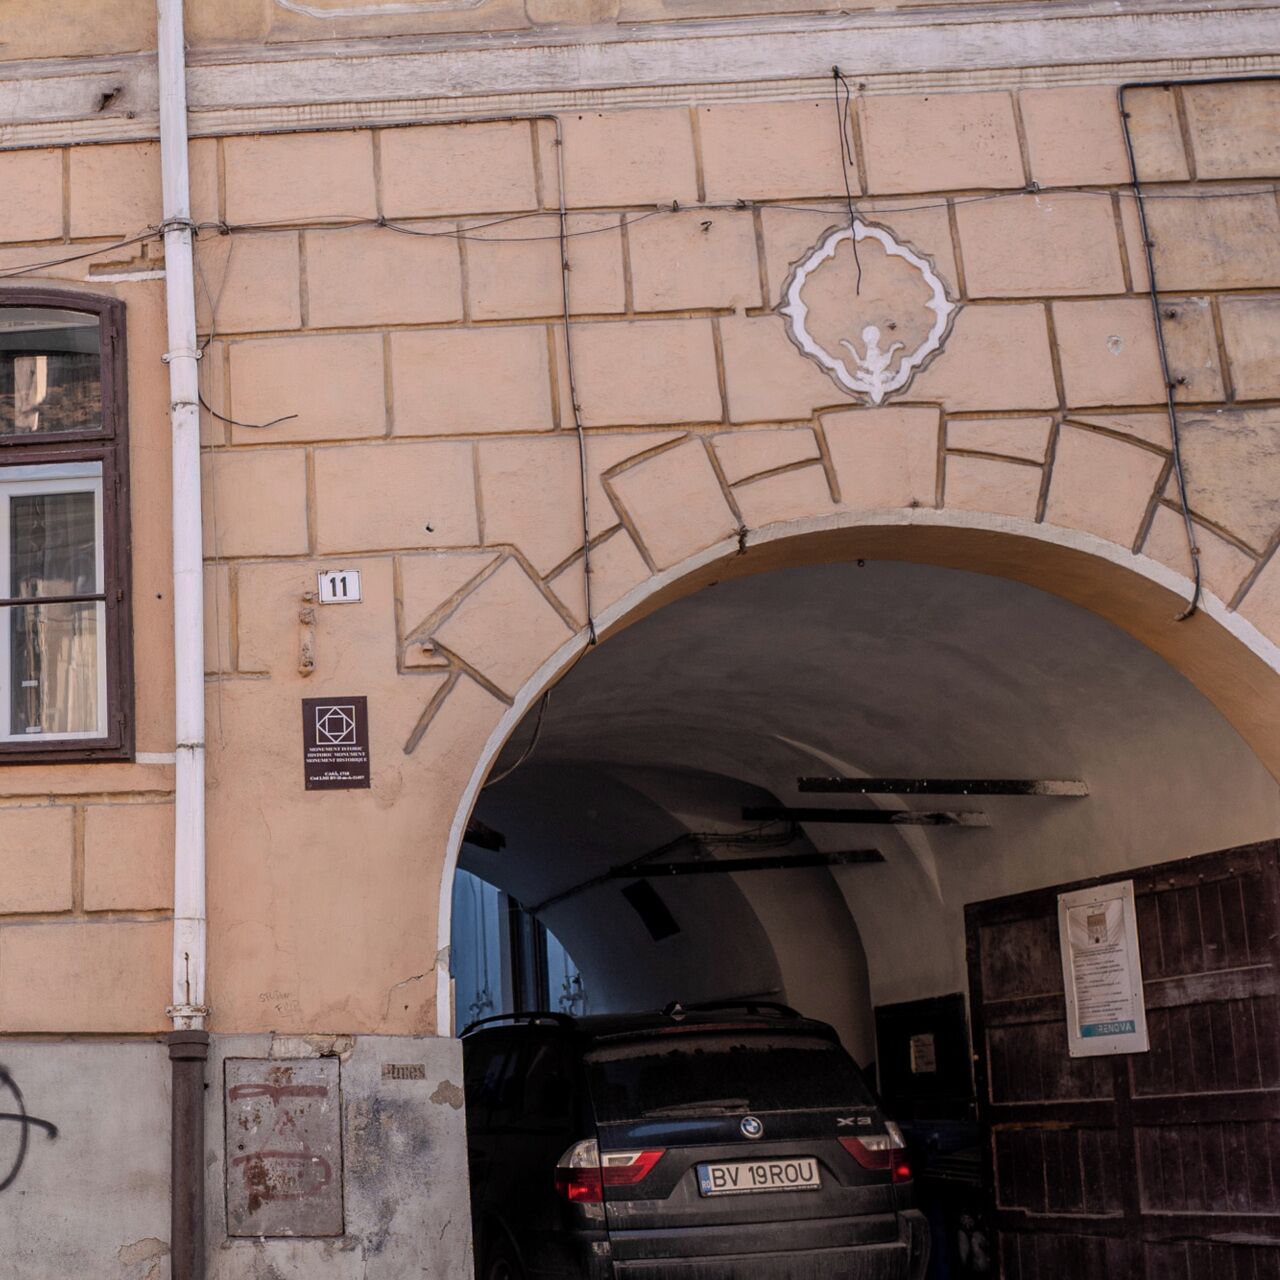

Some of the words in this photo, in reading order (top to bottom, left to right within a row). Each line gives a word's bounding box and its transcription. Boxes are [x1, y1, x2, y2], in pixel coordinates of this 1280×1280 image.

[330, 576, 348, 597] 11
[1098, 1021, 1132, 1033] RENOVA
[836, 1117, 871, 1126] X3
[711, 1167, 739, 1188] BV
